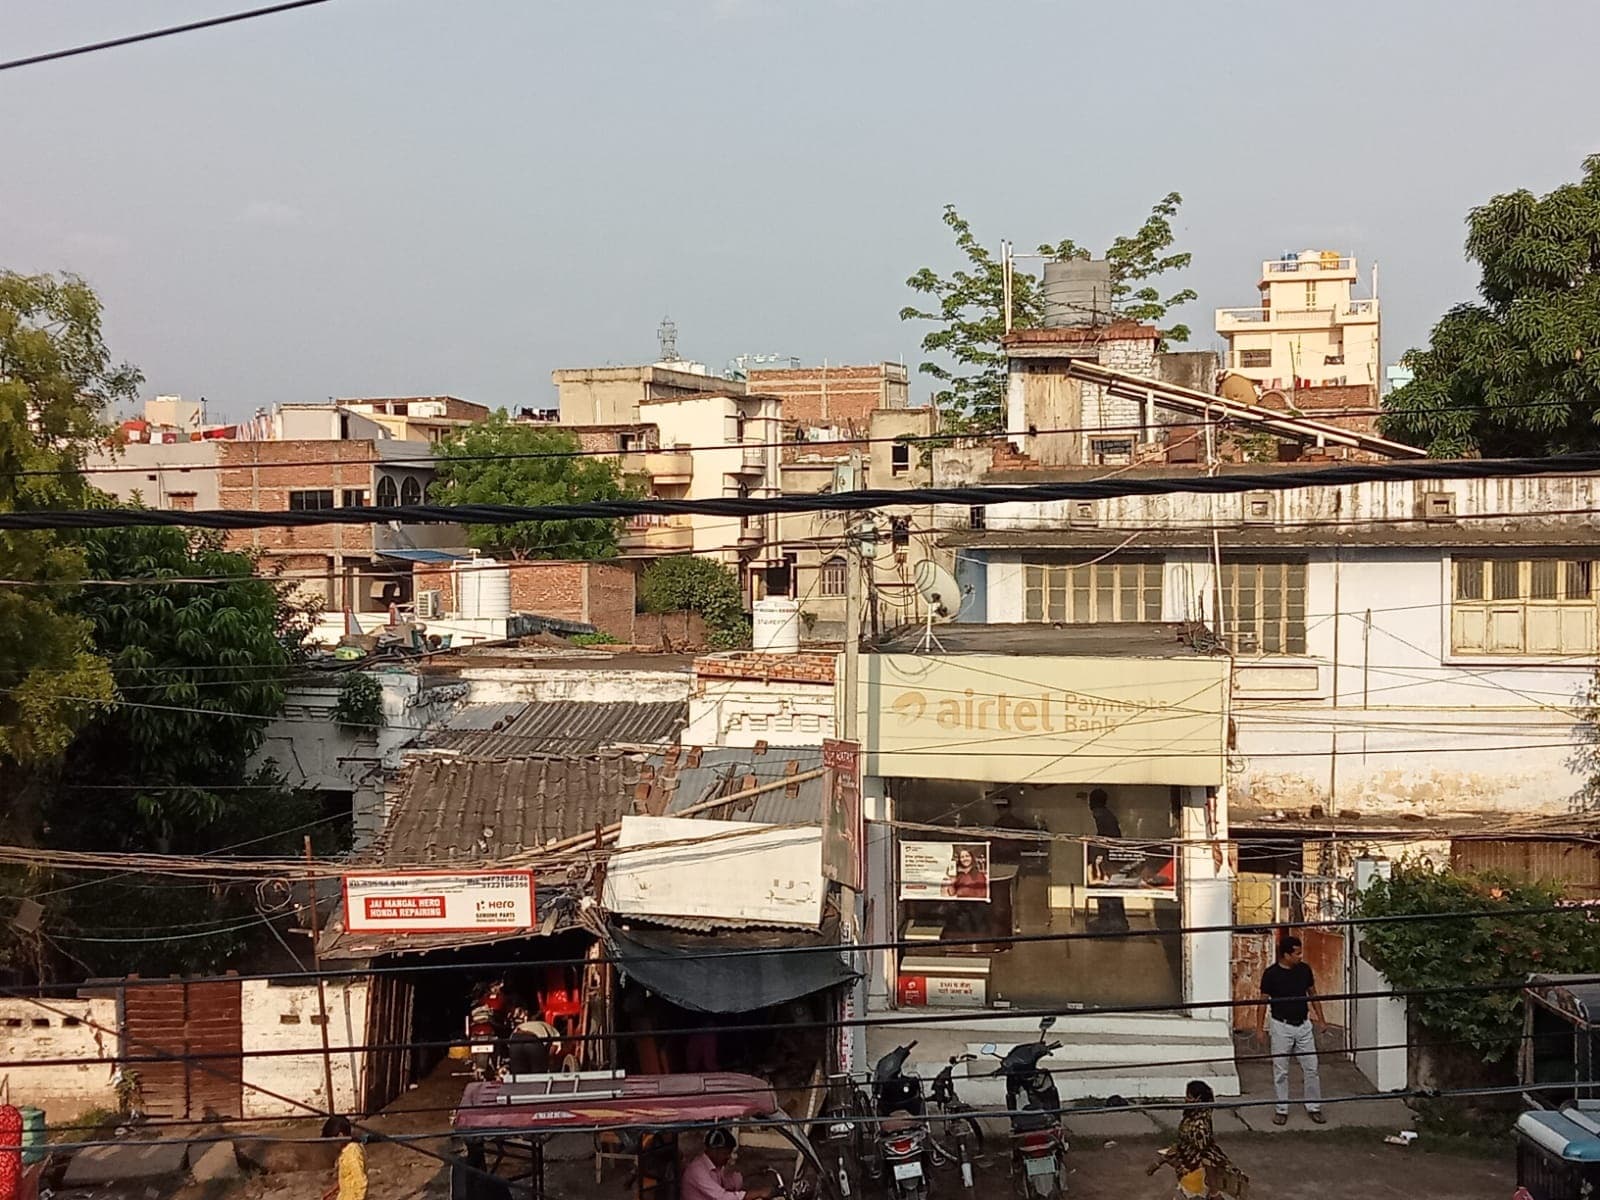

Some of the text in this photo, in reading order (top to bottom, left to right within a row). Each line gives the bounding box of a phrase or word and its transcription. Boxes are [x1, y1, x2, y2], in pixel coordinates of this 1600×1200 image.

[936, 688, 1168, 732] airtel Payments
[1064, 714, 1117, 733] Bank
[369, 898, 440, 908] JAI MANGAL HERO
[489, 900, 515, 909] Hero
[370, 907, 441, 917] HONDA REPAIRING
